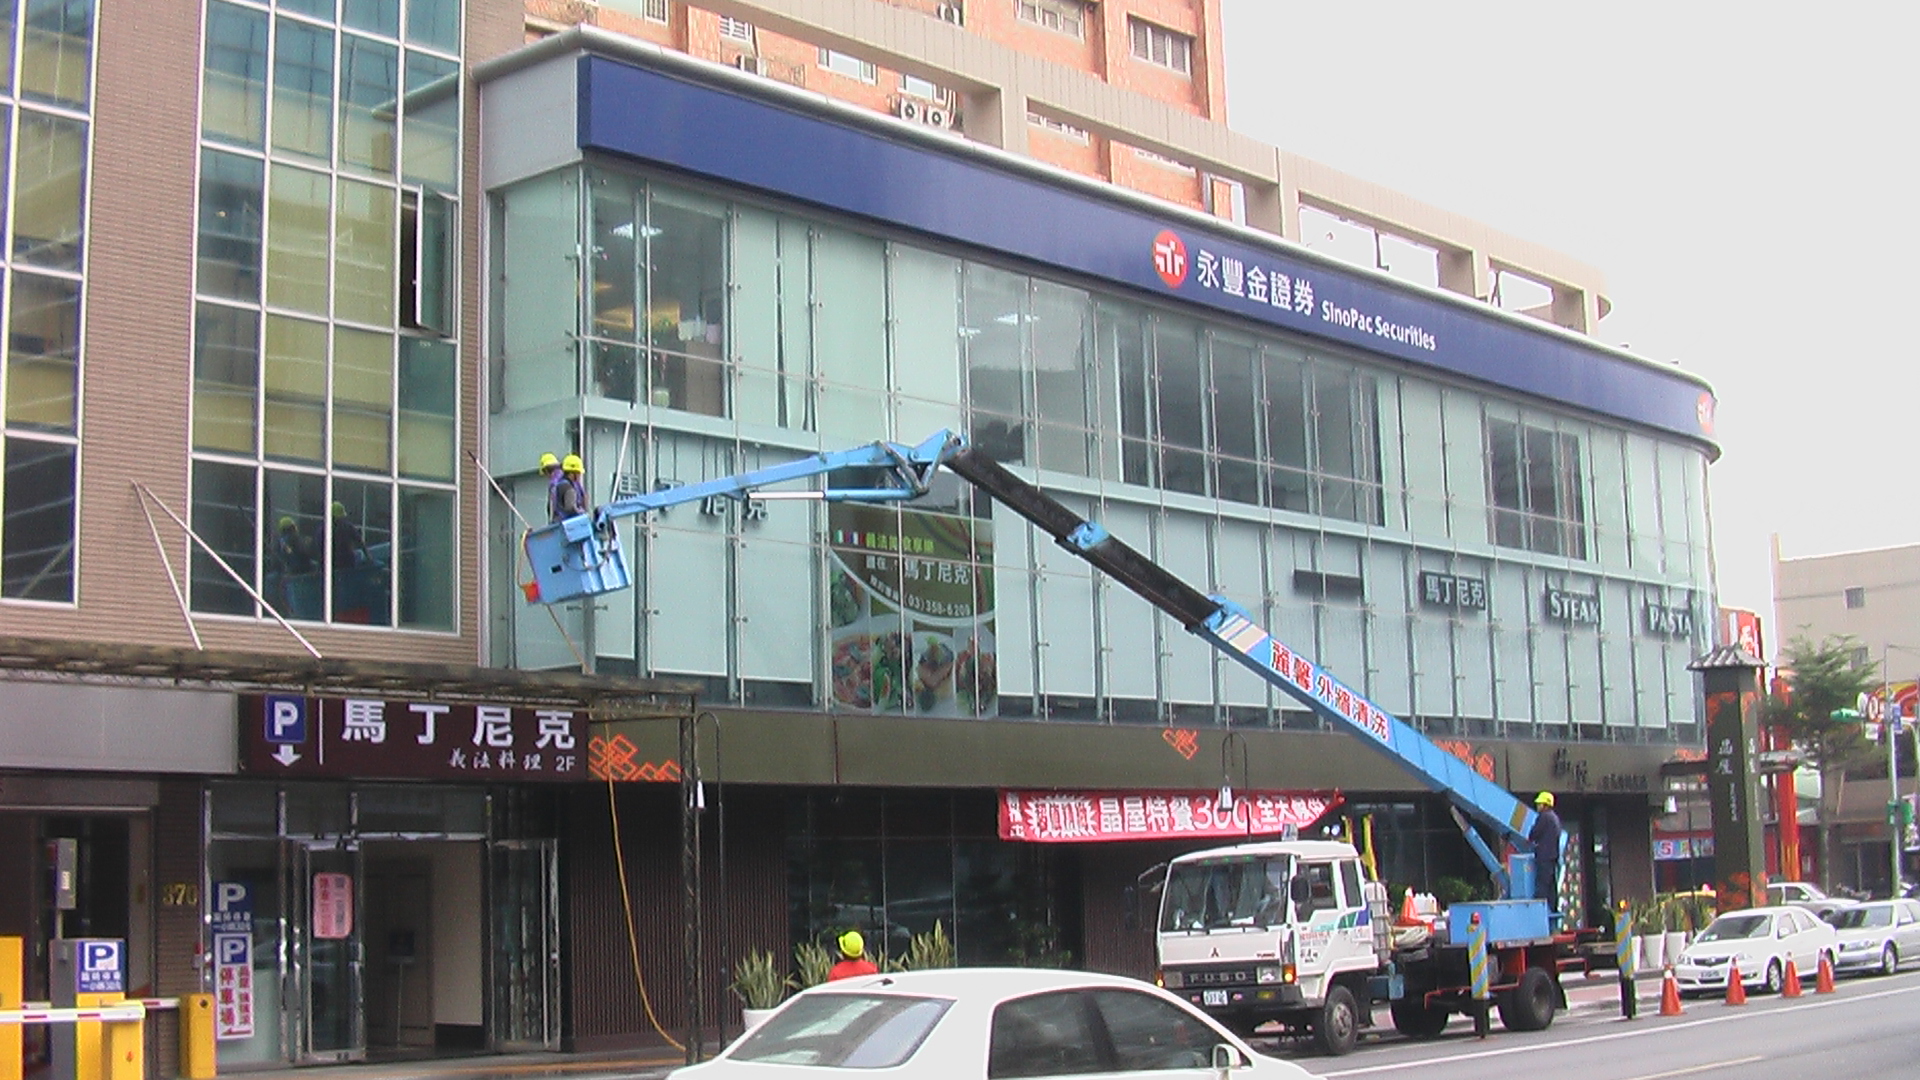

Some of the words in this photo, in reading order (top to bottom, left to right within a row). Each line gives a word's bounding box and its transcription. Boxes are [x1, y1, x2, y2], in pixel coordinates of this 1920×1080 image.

[1197, 249, 1314, 315] 永豐金證券
[1321, 300, 1373, 334] SinoPac
[1375, 315, 1437, 351] Securities
[904, 557, 970, 586] 馬丁尼克
[1425, 574, 1485, 607] 馬丁尼克
[1551, 591, 1600, 623] STEAK
[1650, 605, 1692, 635] PASTA
[274, 701, 299, 736] P
[341, 701, 576, 750] 馬丁尼克
[555, 755, 576, 772] 2F
[218, 882, 247, 912] P
[88, 944, 115, 969] P
[222, 938, 246, 963] P
